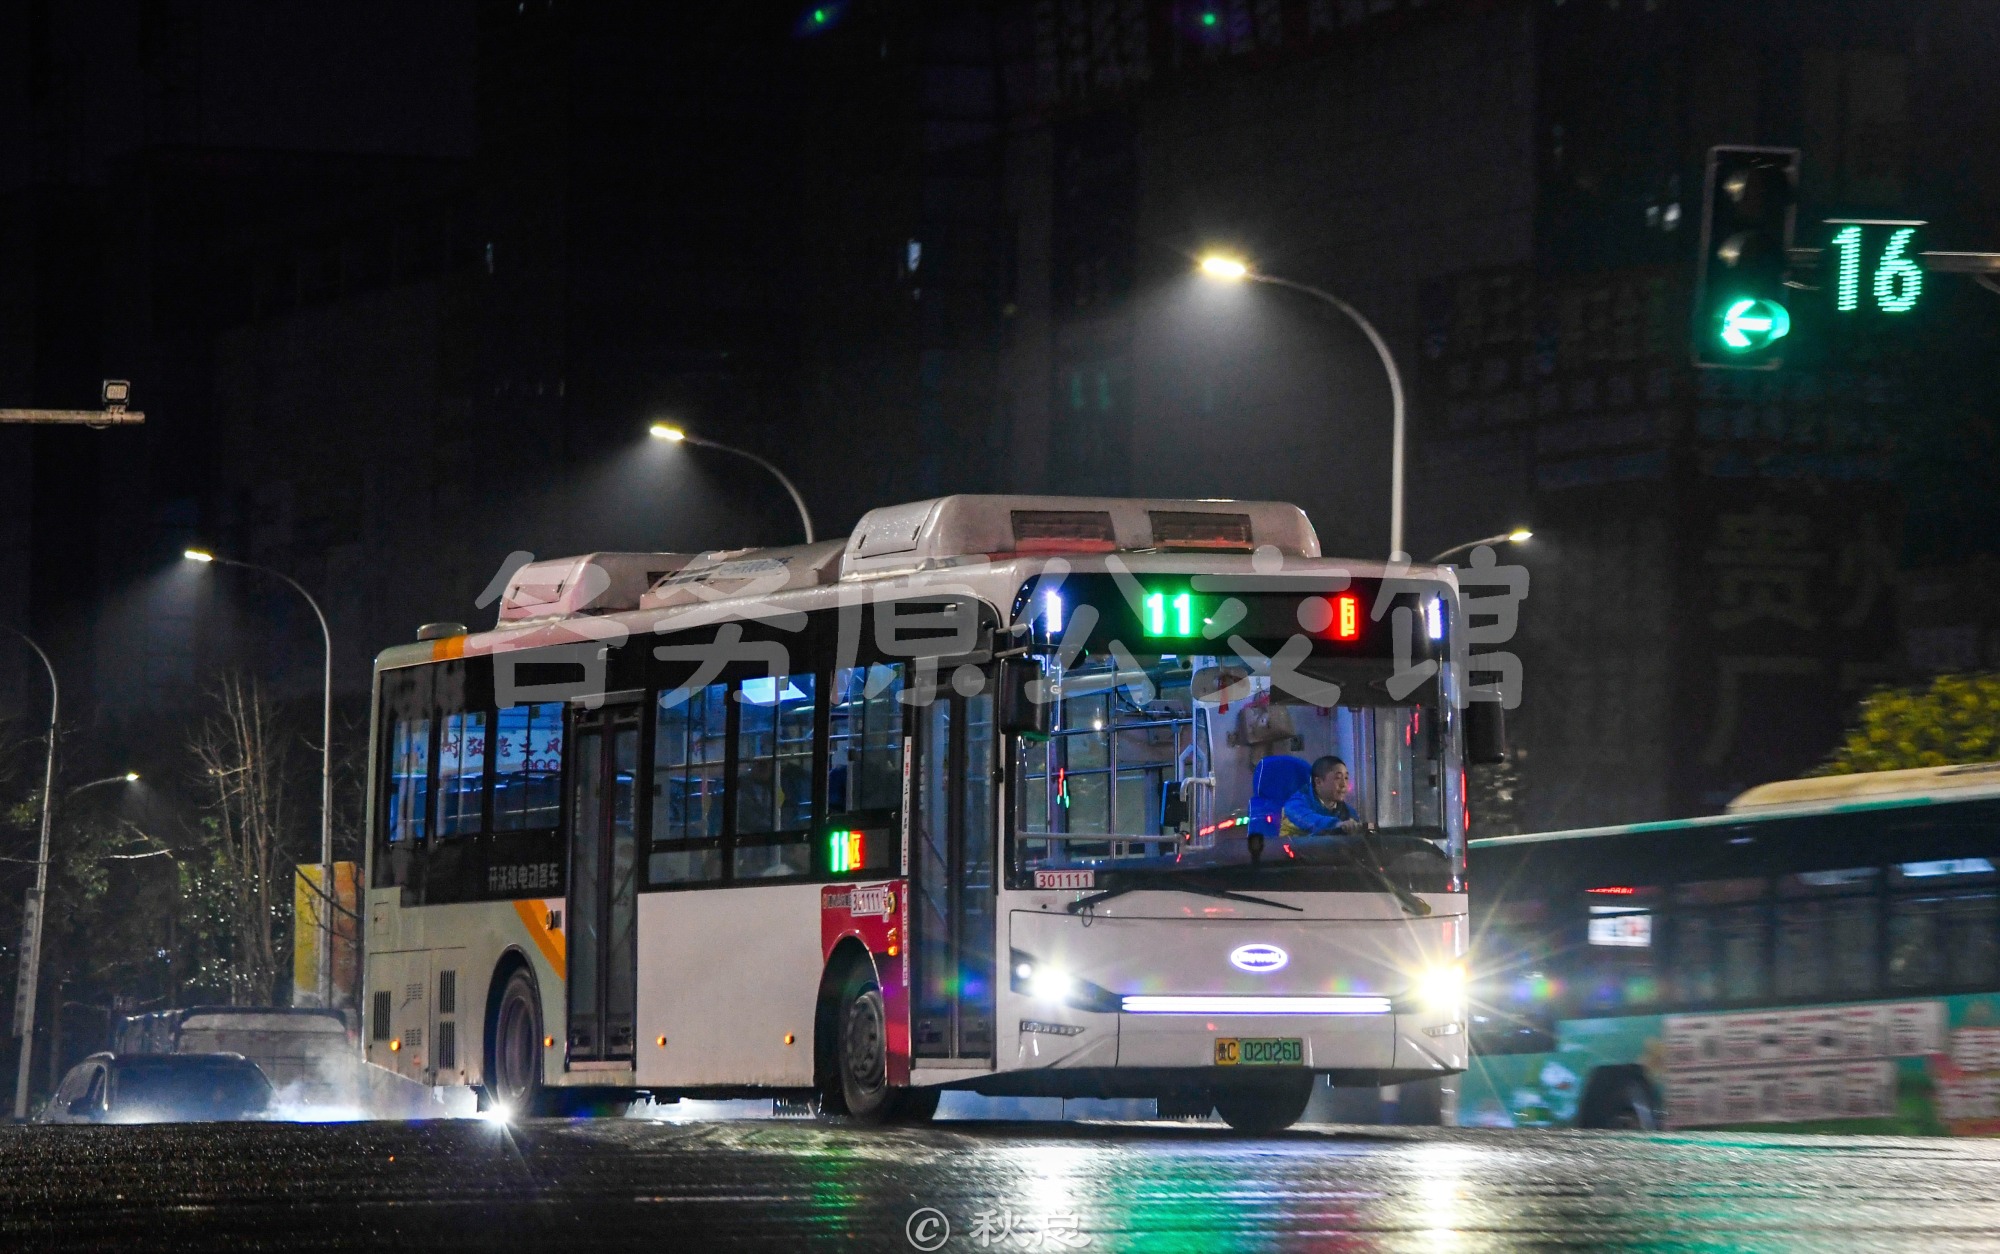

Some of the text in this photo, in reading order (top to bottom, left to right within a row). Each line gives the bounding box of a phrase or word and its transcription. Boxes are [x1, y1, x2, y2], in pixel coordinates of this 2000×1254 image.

[1831, 225, 1924, 313] 16
[1146, 592, 1192, 637] 11
[1038, 873, 1091, 888] 301111
